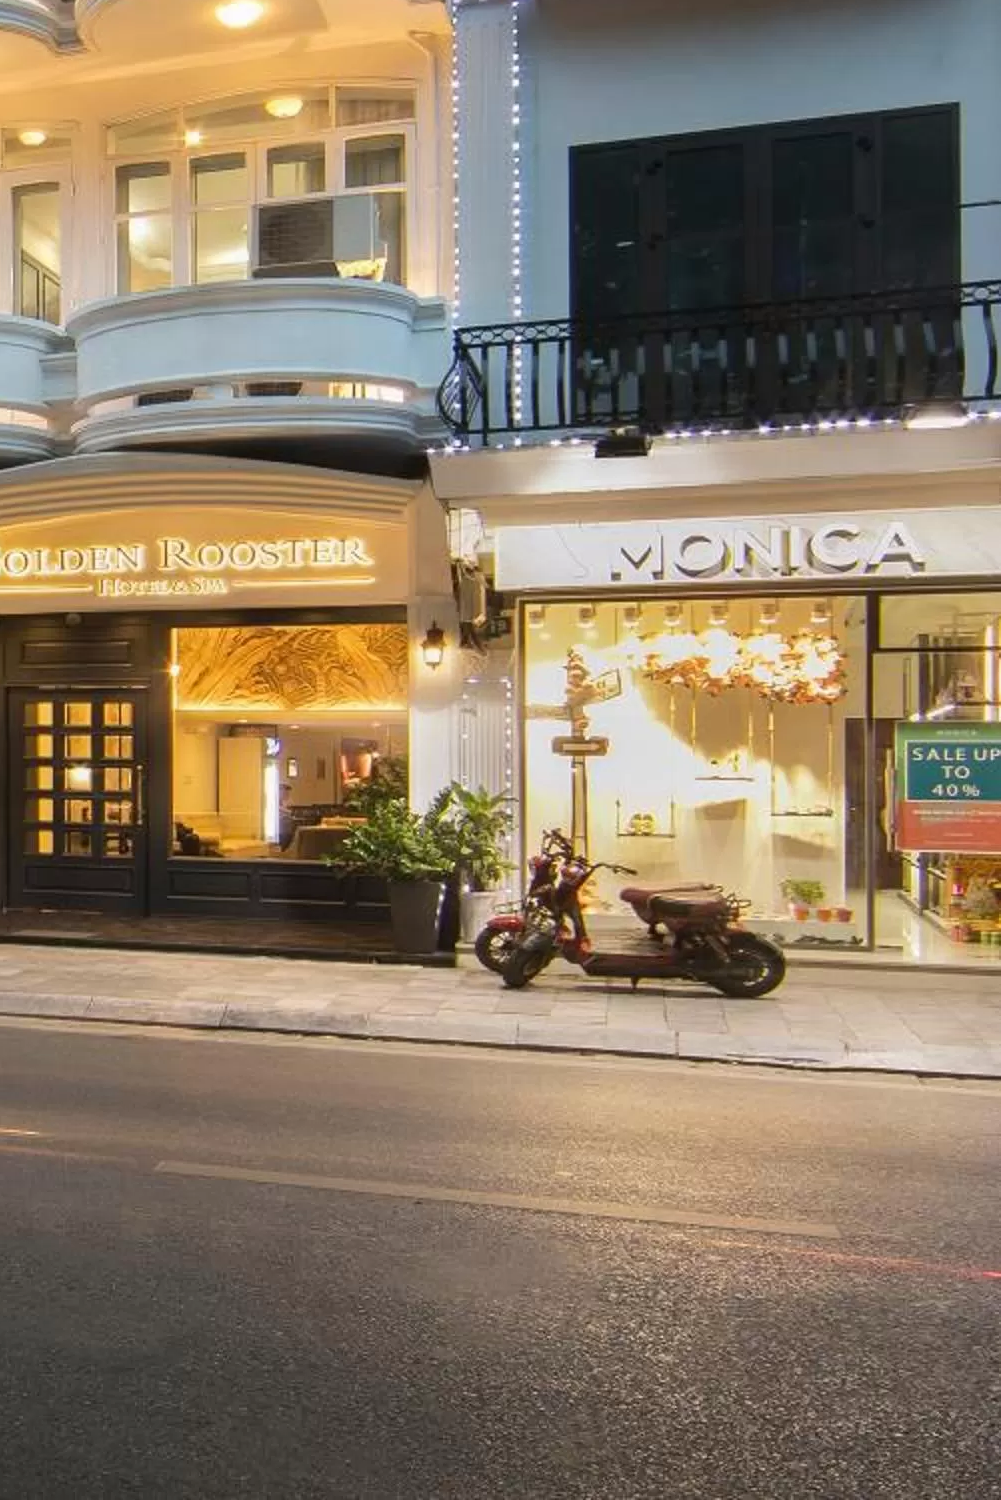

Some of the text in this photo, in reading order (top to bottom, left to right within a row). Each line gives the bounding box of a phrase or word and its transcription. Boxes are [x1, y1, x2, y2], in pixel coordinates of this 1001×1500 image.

[159, 537, 374, 571] ROOSTER
[609, 519, 927, 582] MONICA
[911, 747, 1001, 762] SALE UP
[941, 765, 970, 779] TO
[931, 783, 980, 797] 40%
